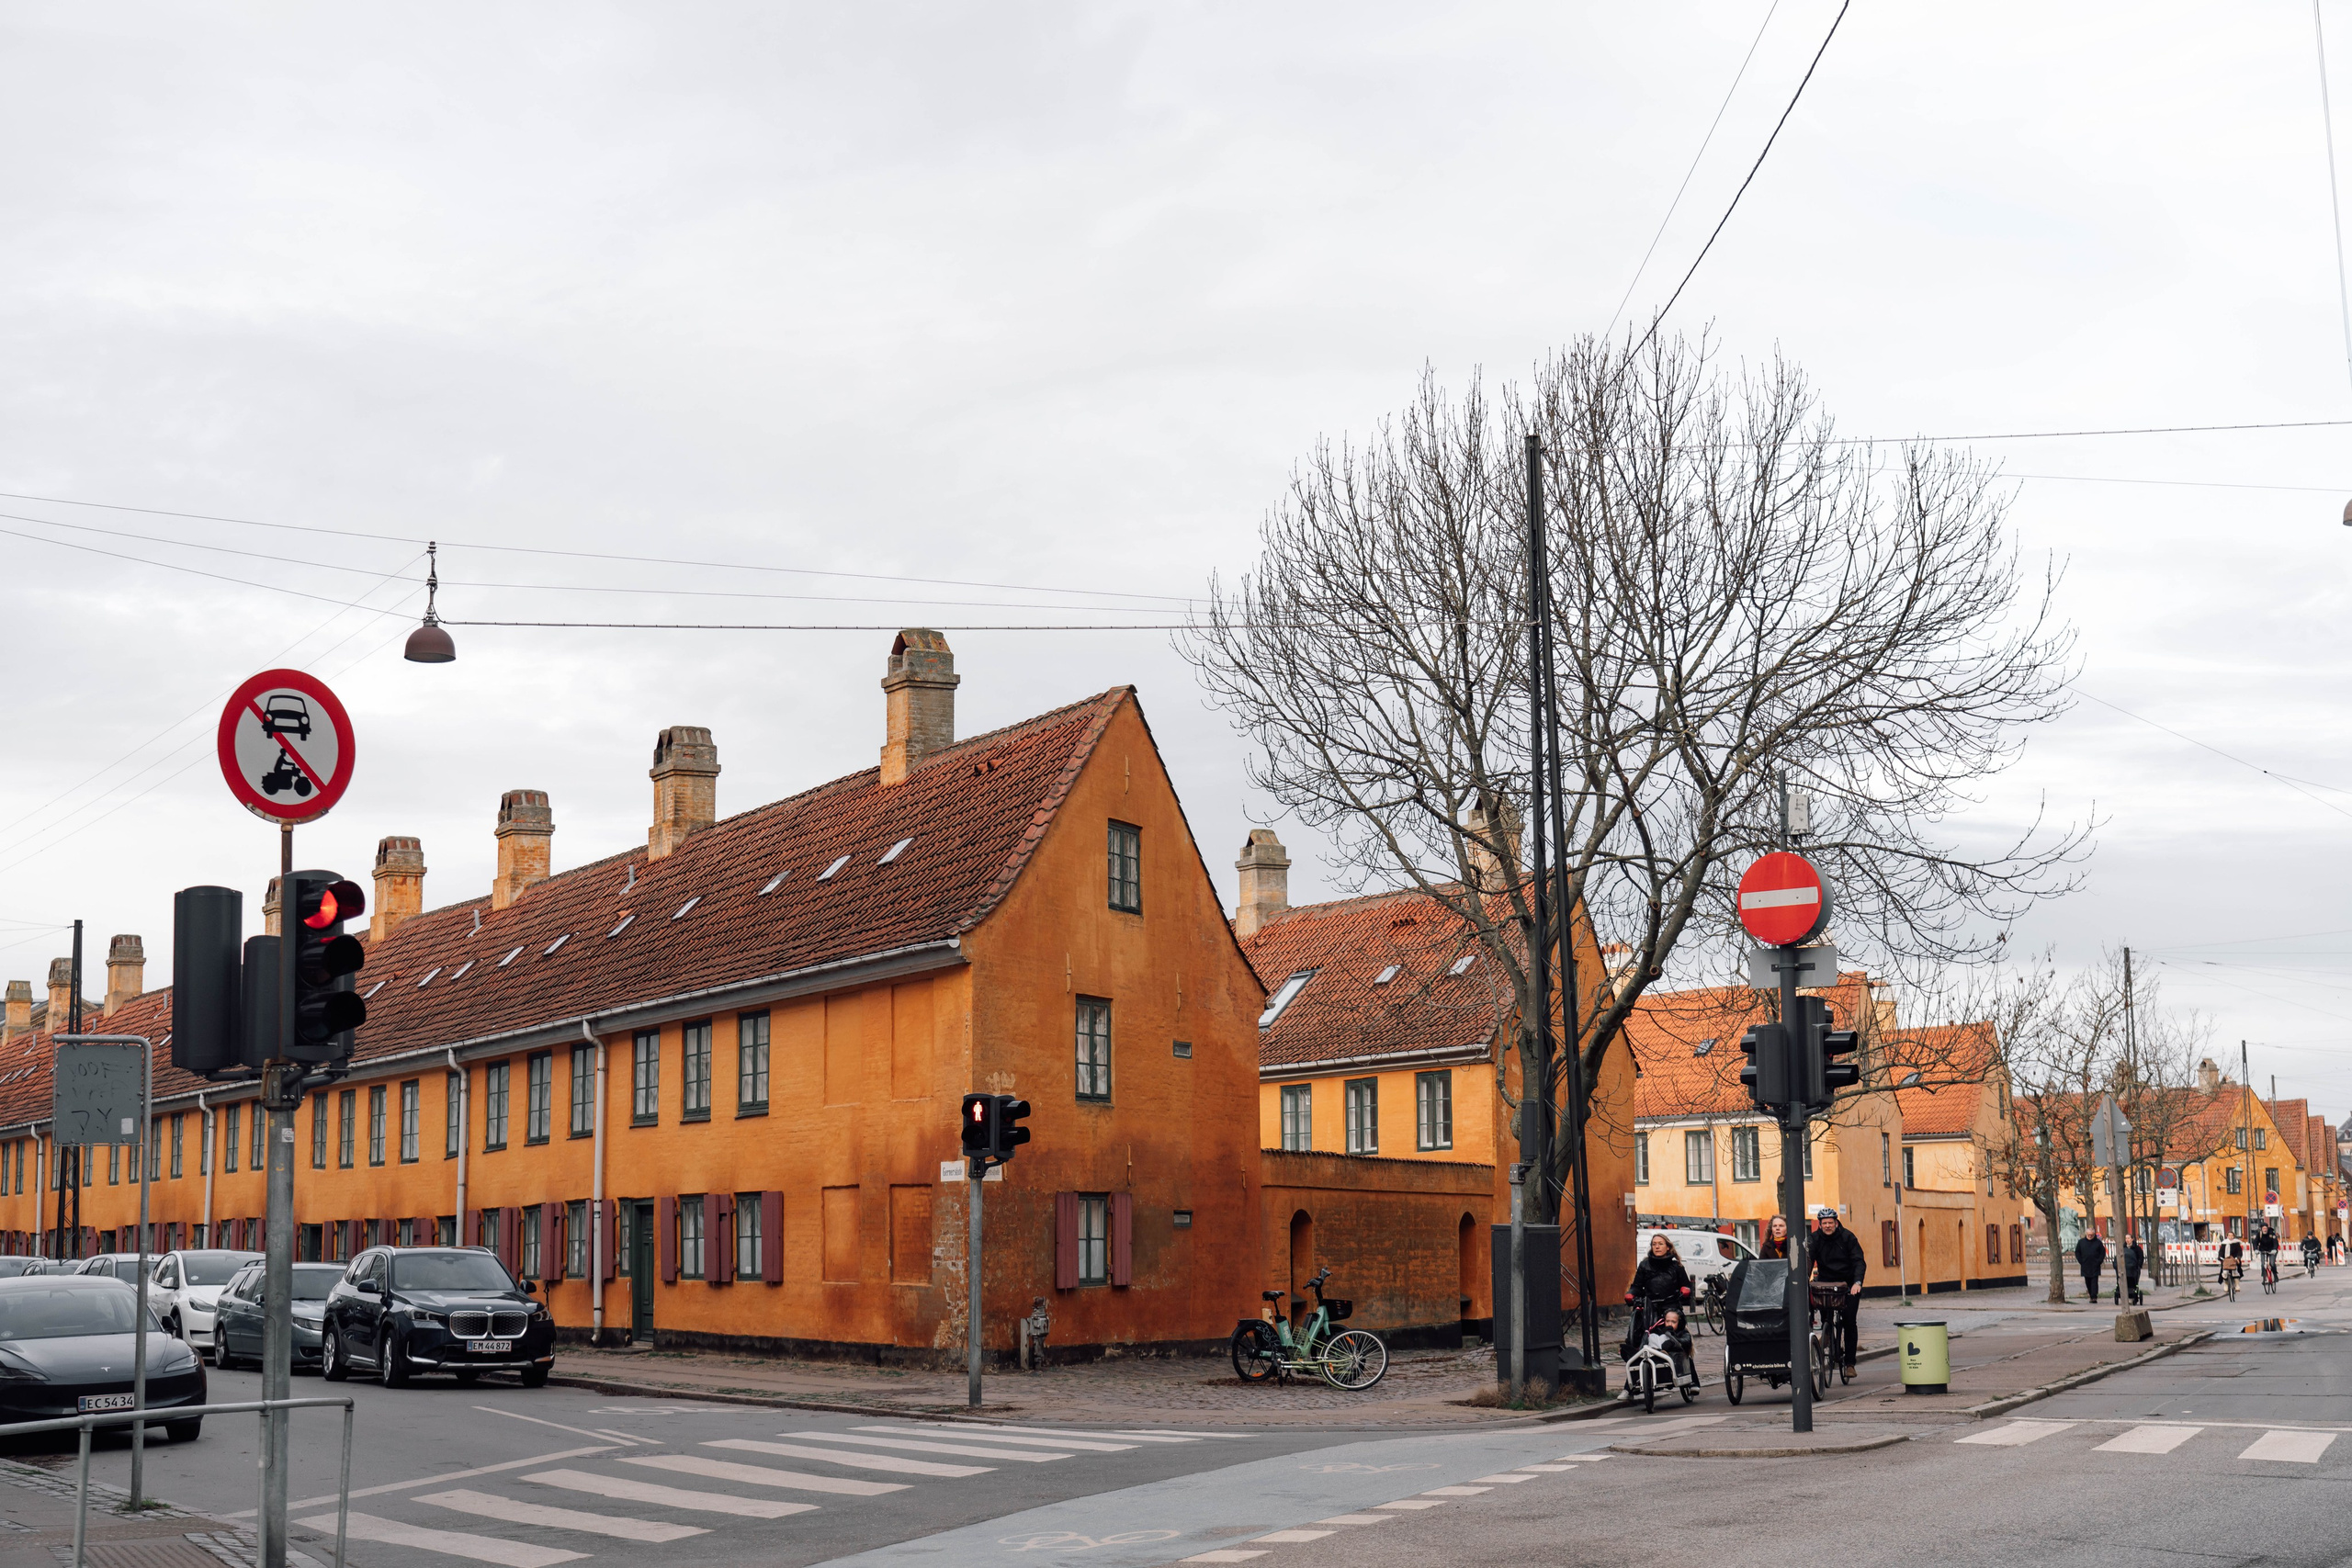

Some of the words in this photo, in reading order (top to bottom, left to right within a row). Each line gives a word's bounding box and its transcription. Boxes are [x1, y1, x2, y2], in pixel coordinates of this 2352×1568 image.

[473, 1342, 483, 1350] EM
[485, 1342, 495, 1350] 44
[496, 1342, 510, 1350] 872
[87, 1398, 101, 1409] EC
[105, 1397, 118, 1408] 54
[120, 1396, 133, 1406] 34
